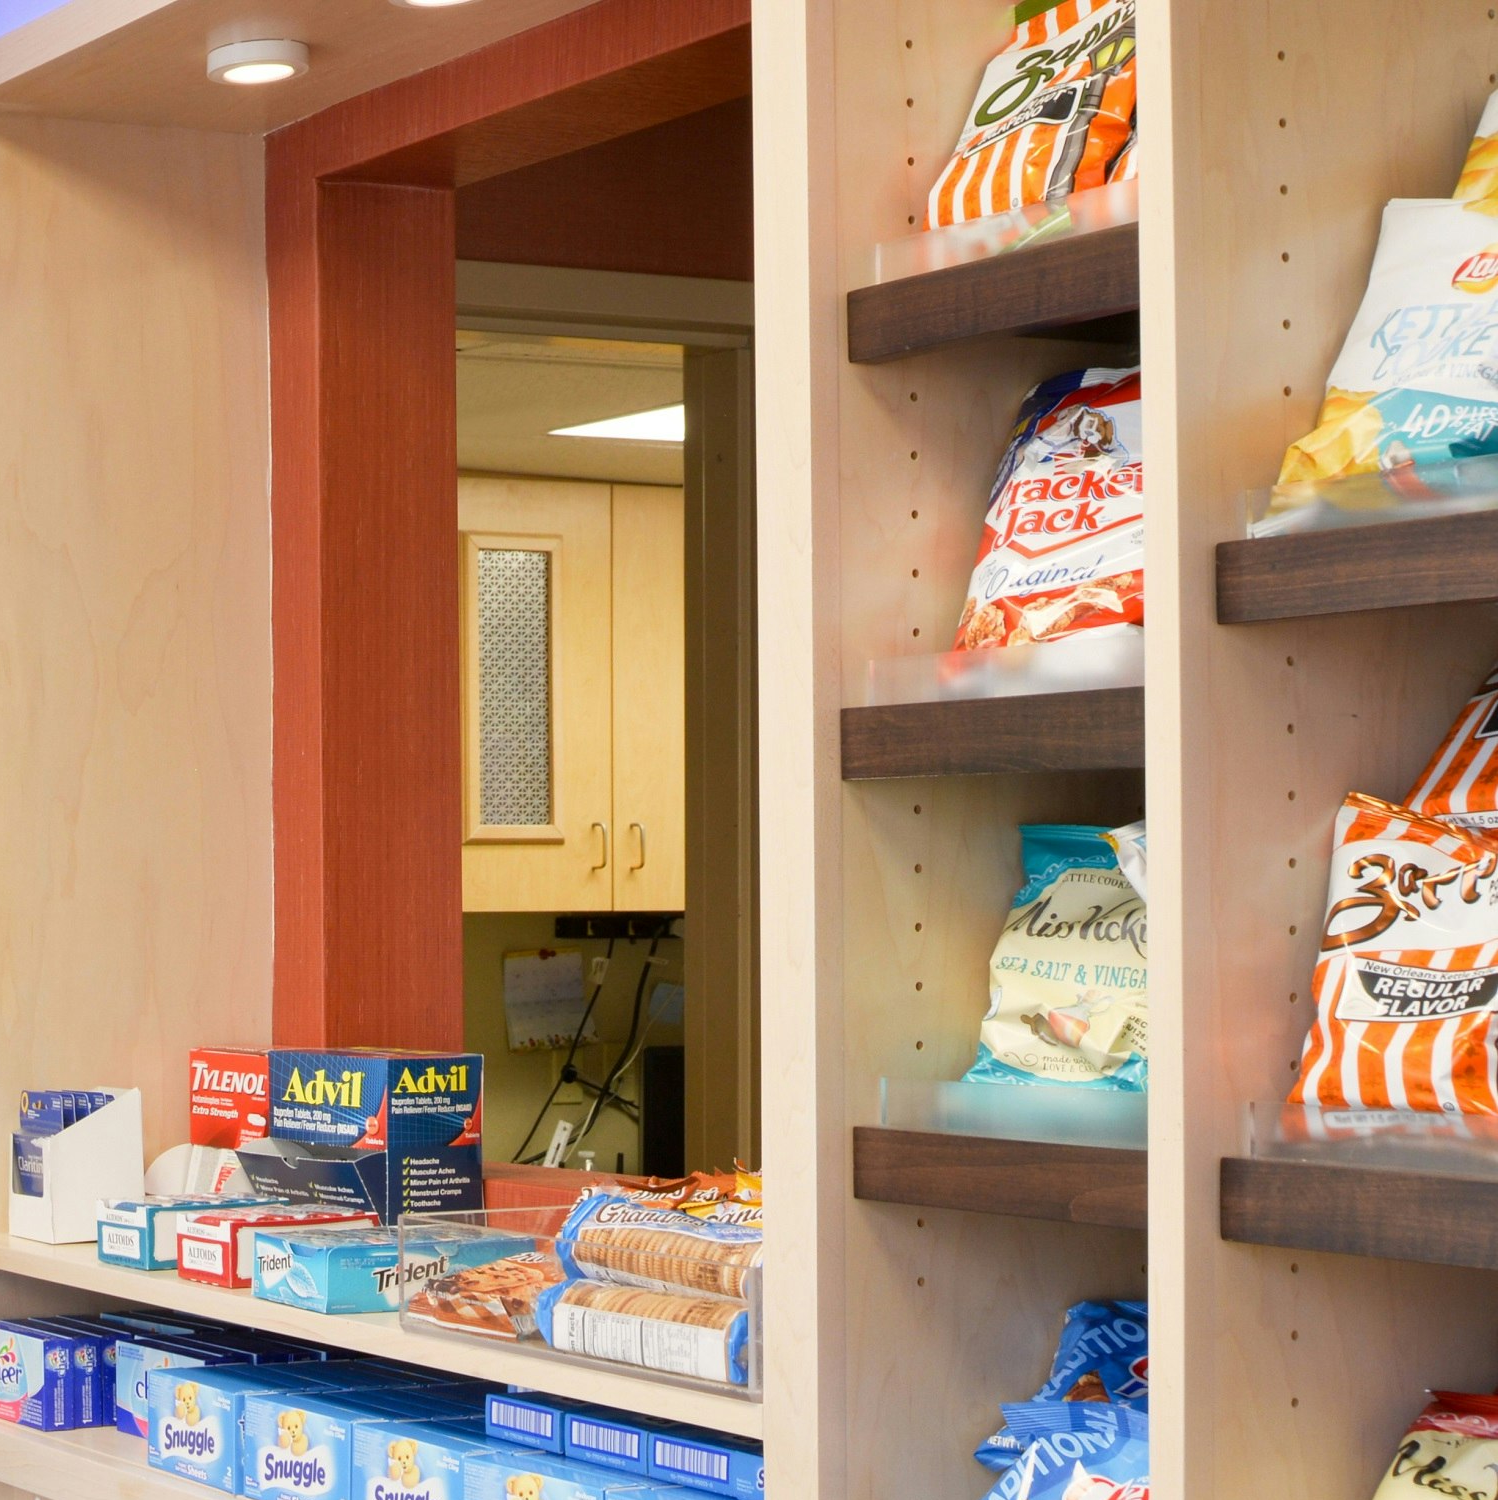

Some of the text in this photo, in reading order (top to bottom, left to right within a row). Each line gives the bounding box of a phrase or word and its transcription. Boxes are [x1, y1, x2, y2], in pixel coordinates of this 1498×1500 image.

[999, 496, 1106, 547] Jack
[1003, 897, 1080, 942] Miss
[995, 956, 1088, 985] SEA SALT &
[1364, 960, 1438, 982] New Orleans
[1373, 976, 1486, 999] REGULAR
[1375, 995, 1471, 1018] FLAVOR
[191, 1061, 266, 1097] TYLENOL
[284, 1064, 364, 1108] Advil
[393, 1064, 468, 1094] Advil
[192, 1106, 239, 1120] Extra Strength
[410, 1156, 441, 1167] Headache
[410, 1166, 456, 1177] Muscular Aches
[410, 1174, 471, 1187] Minor Arthritis
[410, 1187, 462, 1199] Menstrual Cramps
[410, 1198, 441, 1208] Toothache
[107, 1232, 135, 1248] ALTOIDS
[187, 1246, 218, 1262] ALTOIDS
[257, 1253, 293, 1273] Trident
[372, 1254, 449, 1294] Trident
[164, 1423, 215, 1456] Snuggle
[187, 1463, 208, 1481] Sheets
[264, 1452, 326, 1488] Snuggle
